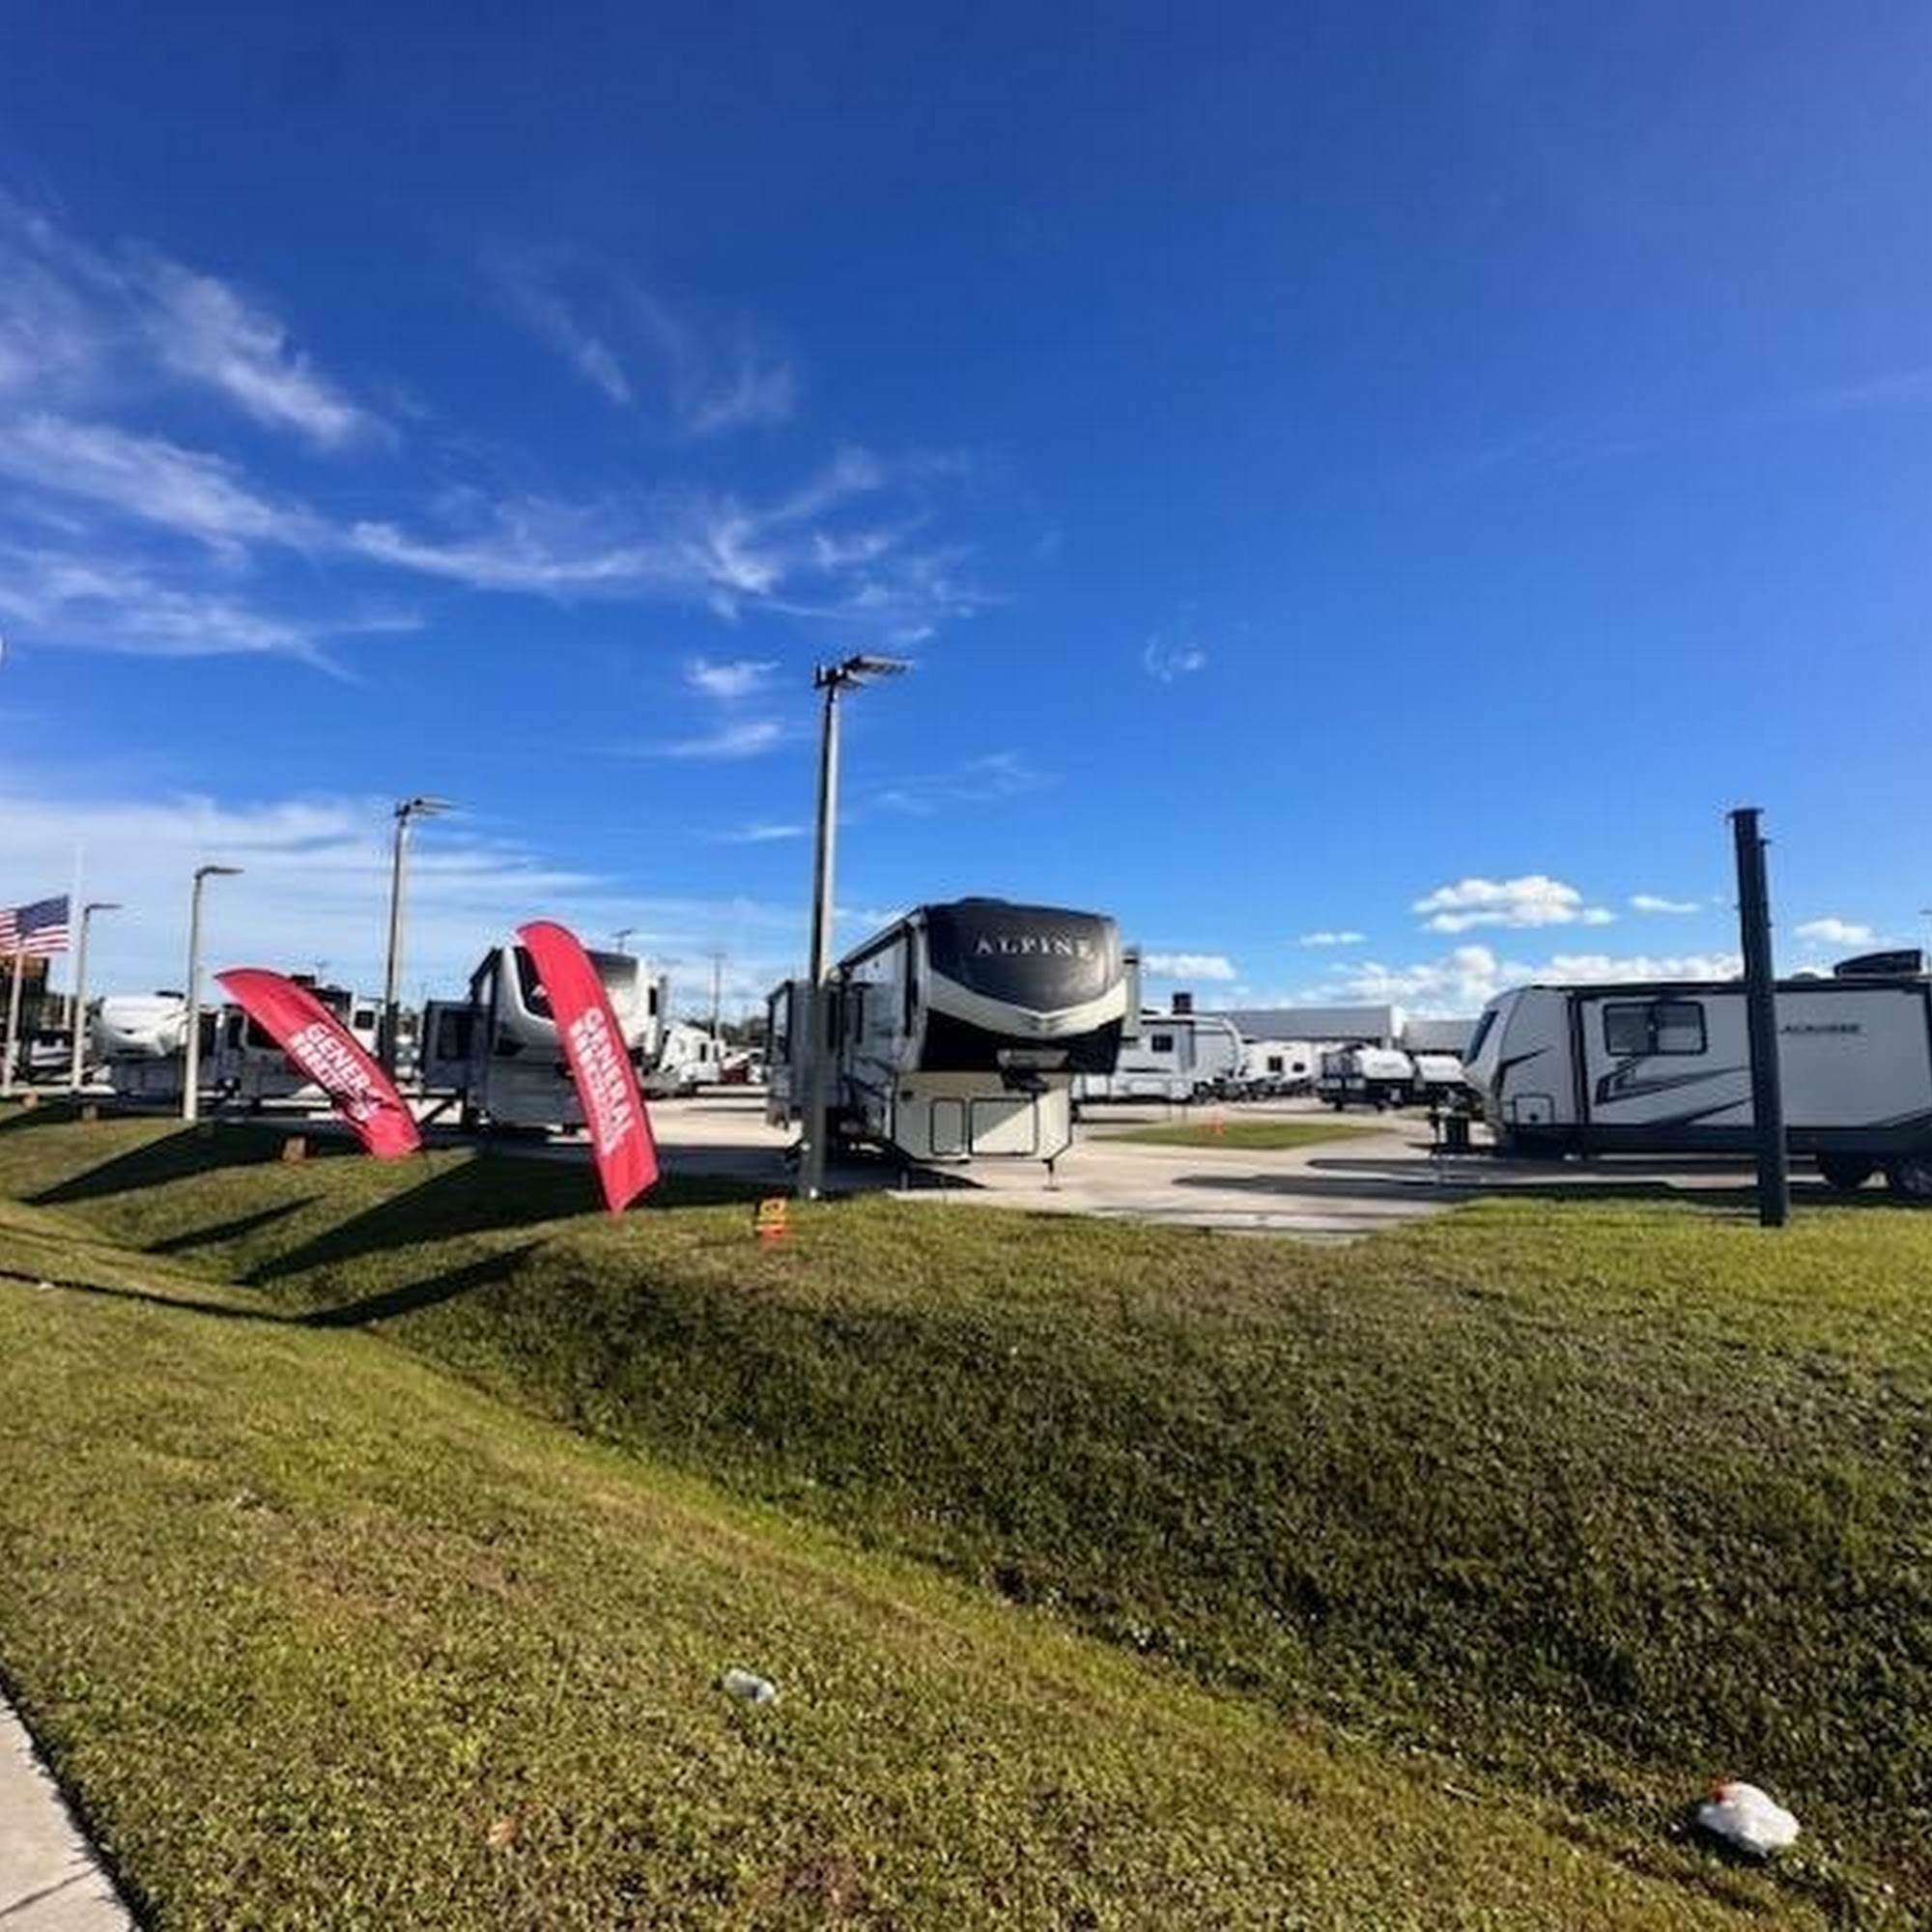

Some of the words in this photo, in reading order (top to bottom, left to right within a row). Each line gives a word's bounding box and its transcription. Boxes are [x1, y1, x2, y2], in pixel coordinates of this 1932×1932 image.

[975, 934, 1096, 960] ALPINE
[304, 1023, 381, 1113] GENER
[583, 1008, 636, 1133] GENERAL
